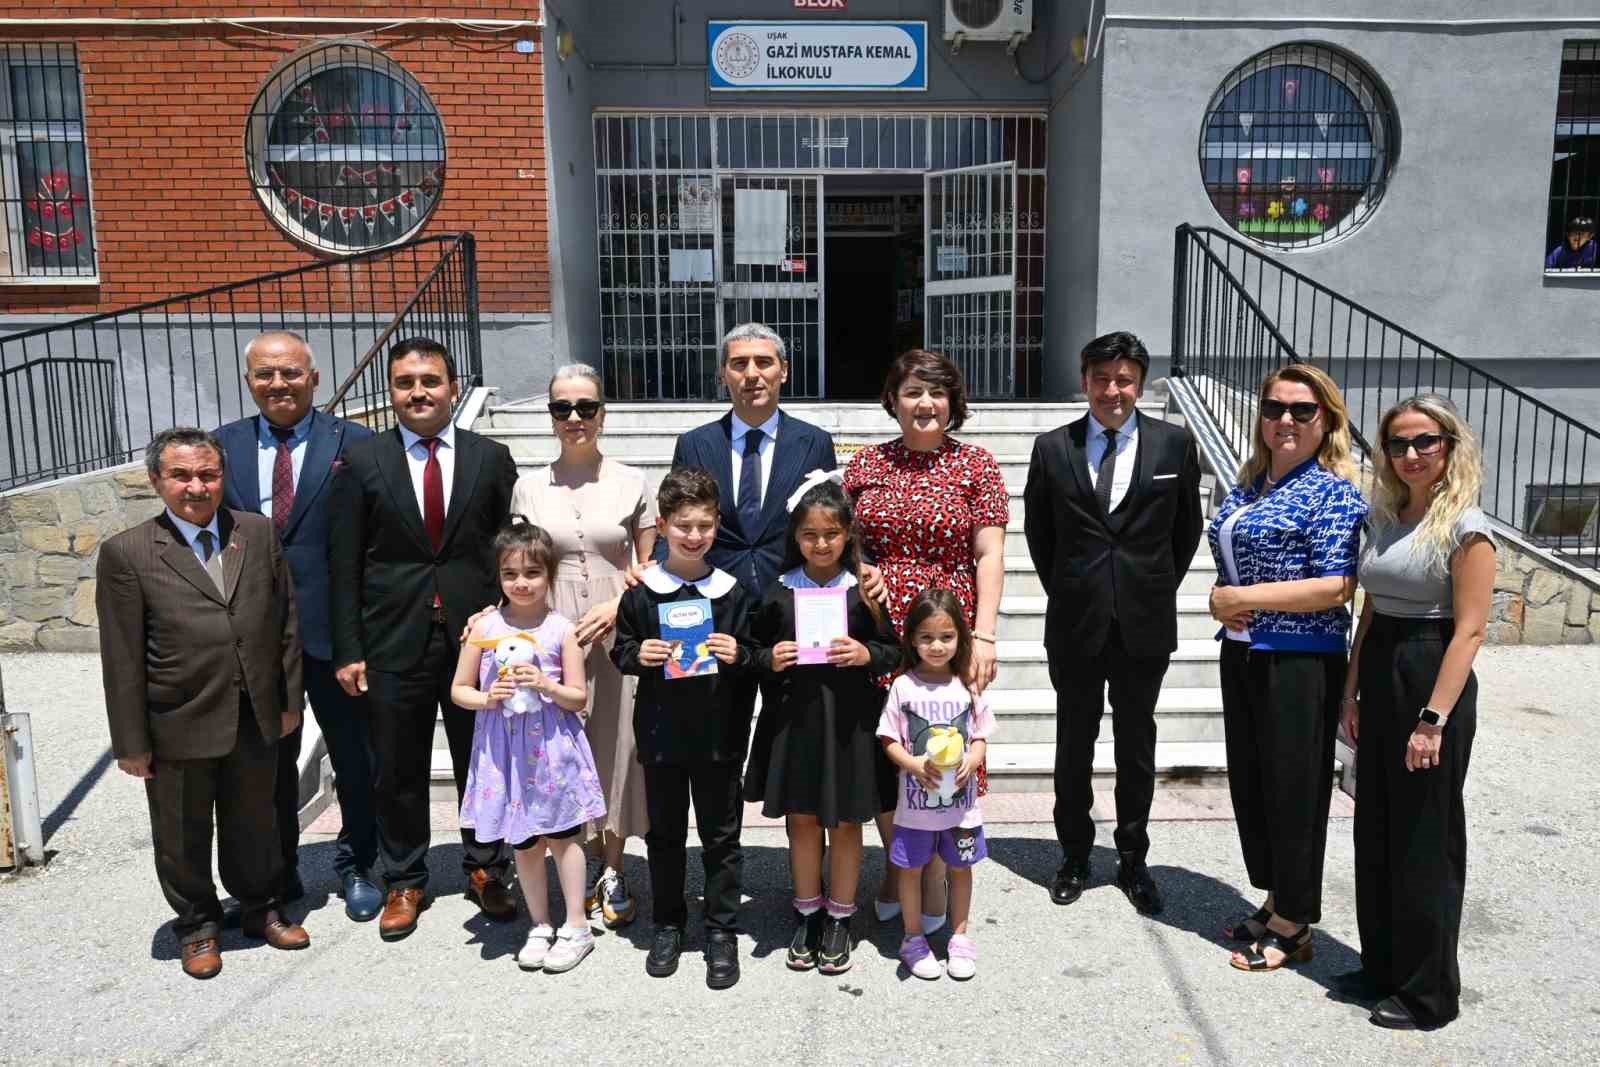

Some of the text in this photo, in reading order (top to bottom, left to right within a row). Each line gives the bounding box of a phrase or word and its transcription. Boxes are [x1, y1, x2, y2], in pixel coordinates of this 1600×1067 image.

[767, 32, 788, 41] UŞAK
[766, 42, 911, 58] GAZİ MUSTAFA KEMAL
[767, 64, 832, 79] İLKOKULU
